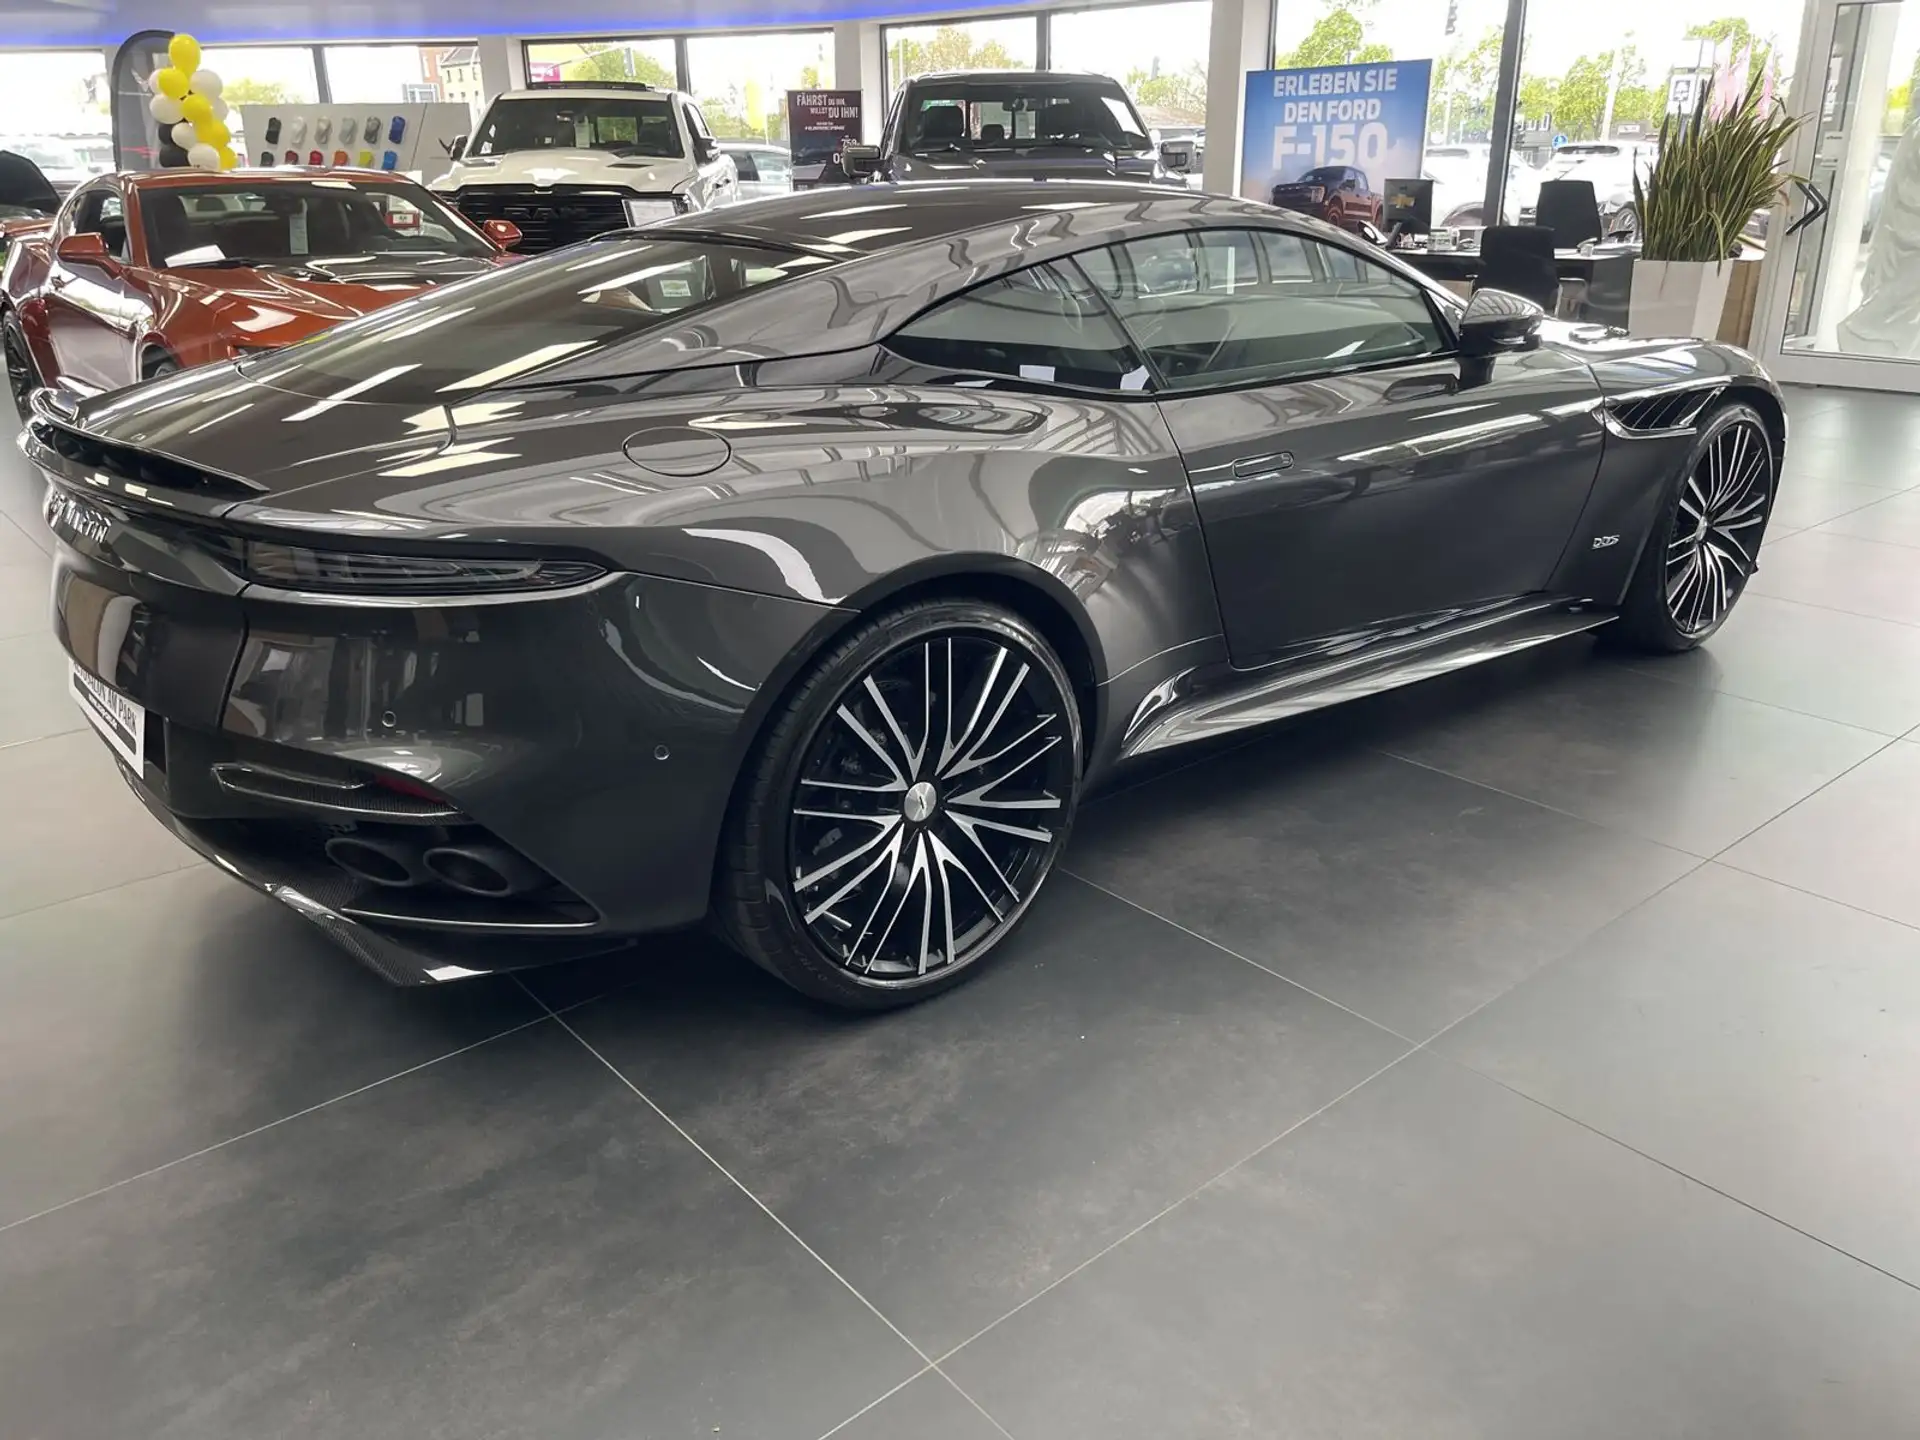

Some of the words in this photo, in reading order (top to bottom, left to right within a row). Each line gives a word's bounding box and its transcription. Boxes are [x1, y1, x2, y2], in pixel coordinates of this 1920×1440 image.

[1273, 71, 1361, 97] ERLEBEN
[1364, 68, 1398, 92] SIE
[796, 92, 828, 106] FÄHRST
[1284, 102, 1323, 123] DEN
[1326, 99, 1382, 121] FORD
[828, 106, 839, 118] DU
[841, 106, 858, 118] IHN!
[1272, 122, 1389, 171] F-150
